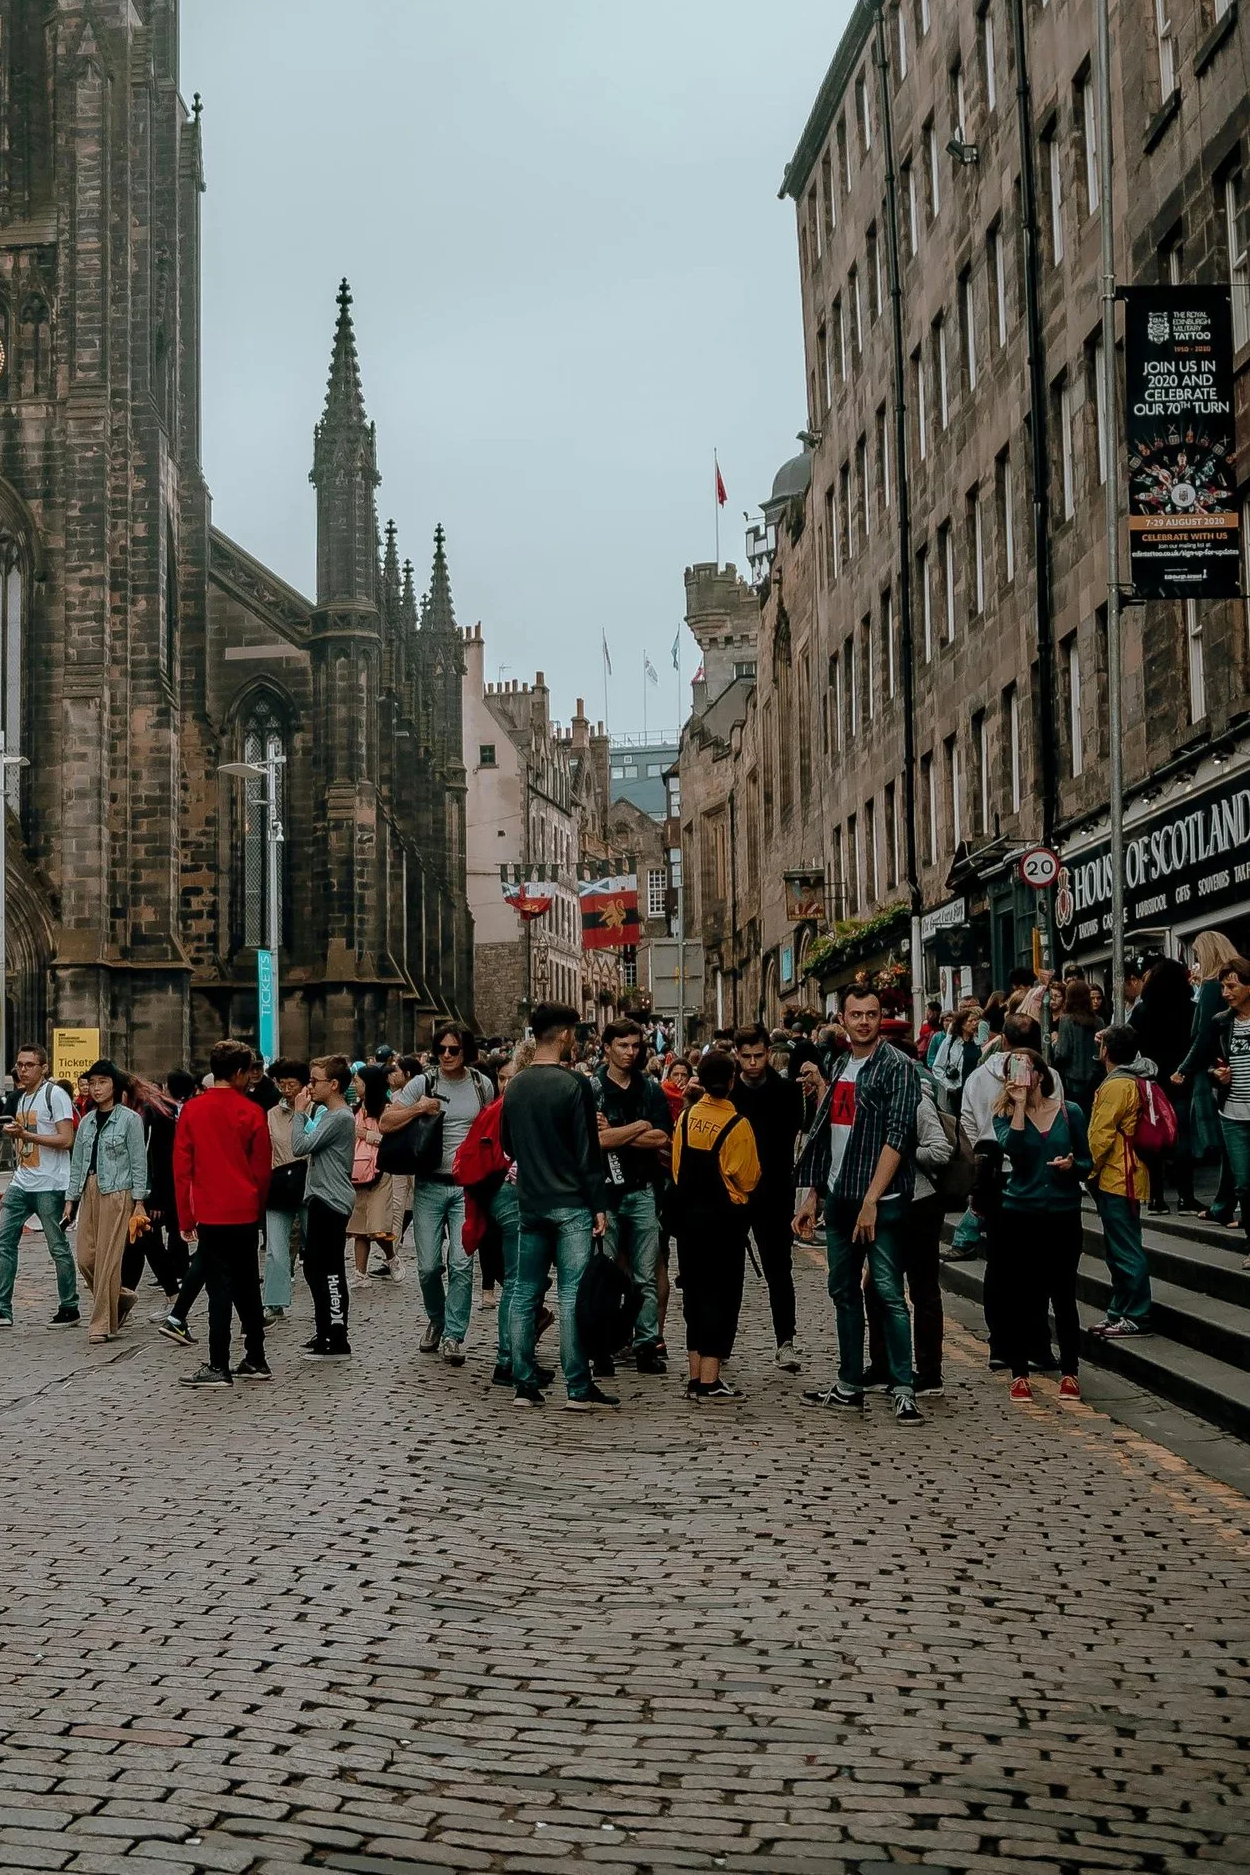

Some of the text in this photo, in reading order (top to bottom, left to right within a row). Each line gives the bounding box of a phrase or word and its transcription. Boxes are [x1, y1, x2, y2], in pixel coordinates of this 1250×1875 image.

[1173, 332, 1211, 341] TATTOO
[1142, 360, 1216, 377] JOIN US IN
[1147, 374, 1214, 388] 2020 AND
[1144, 388, 1218, 401] CELEBRATE
[1133, 401, 1230, 415] OUR 70TH TURN
[1145, 517, 1225, 527] 7-29 AUGUST 2020
[1141, 532, 1228, 542] CELEBRATE WITH US
[1075, 789, 1250, 911] HOUS OF SCOTLAND
[1026, 860, 1053, 876] 20
[1175, 884, 1191, 904] GIFTS
[261, 955, 271, 1017] TICKETS
[58, 1058, 94, 1068] Tickets
[58, 1070, 71, 1078] on
[688, 1116, 721, 1136] TAFF
[327, 1274, 342, 1316] Hurley
